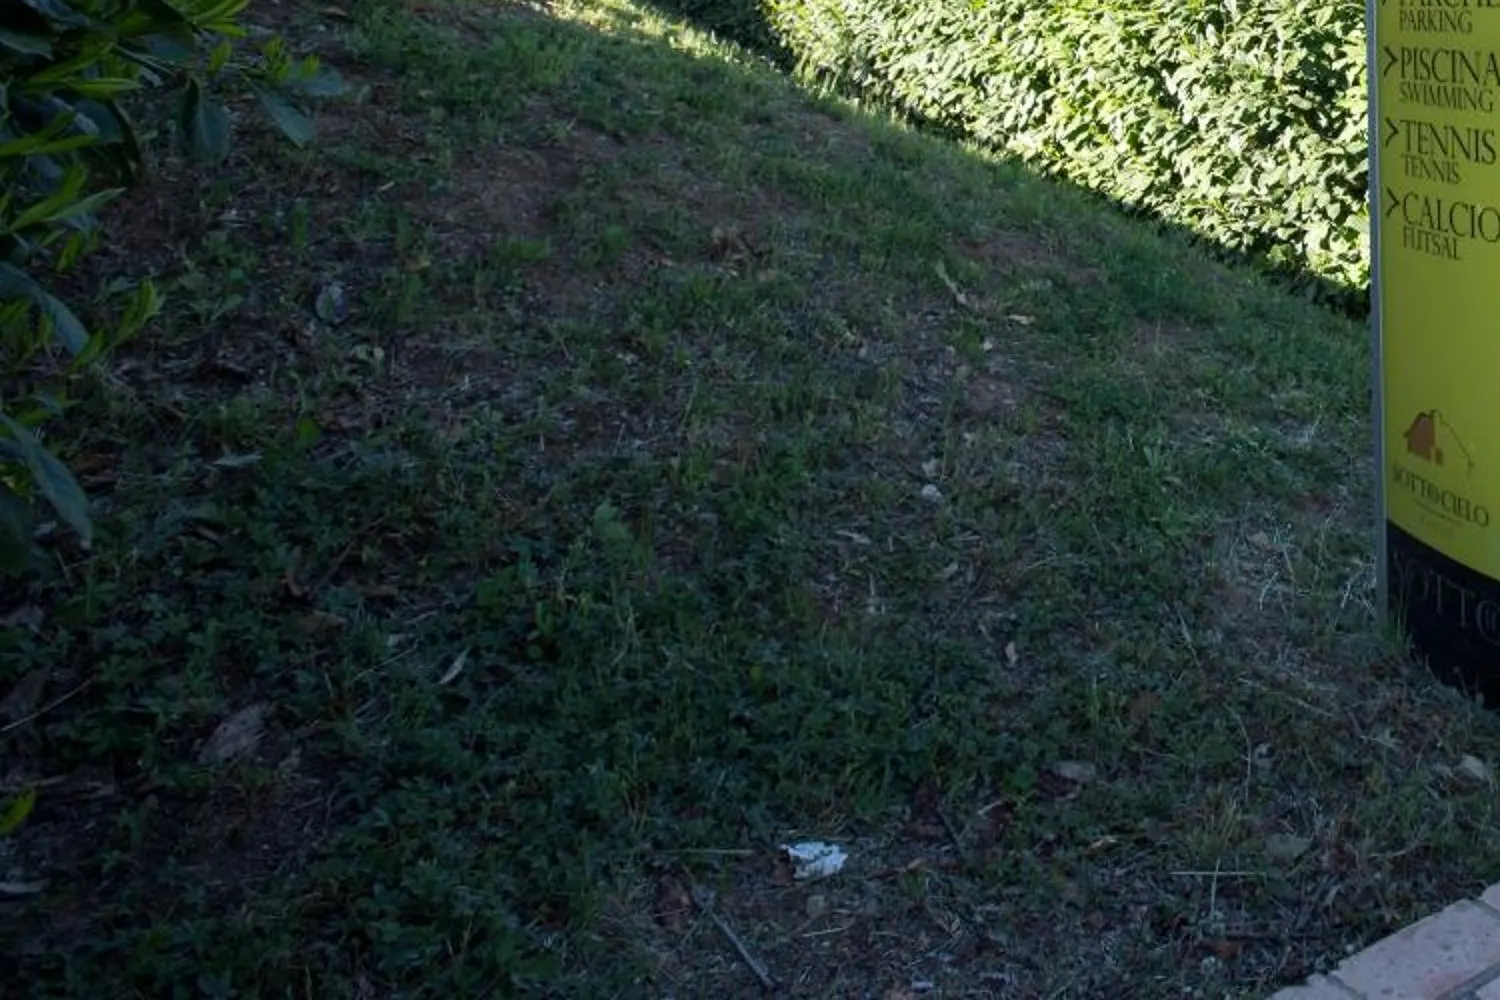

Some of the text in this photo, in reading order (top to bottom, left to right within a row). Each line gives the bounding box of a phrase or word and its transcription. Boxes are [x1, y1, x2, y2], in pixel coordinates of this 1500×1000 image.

[1399, 9, 1473, 34] PARKING
[1400, 81, 1494, 113] SWIMMING
[1400, 119, 1497, 165] TENNIS
[1401, 154, 1461, 185] TENNIS
[1403, 226, 1463, 261] FUTSAL
